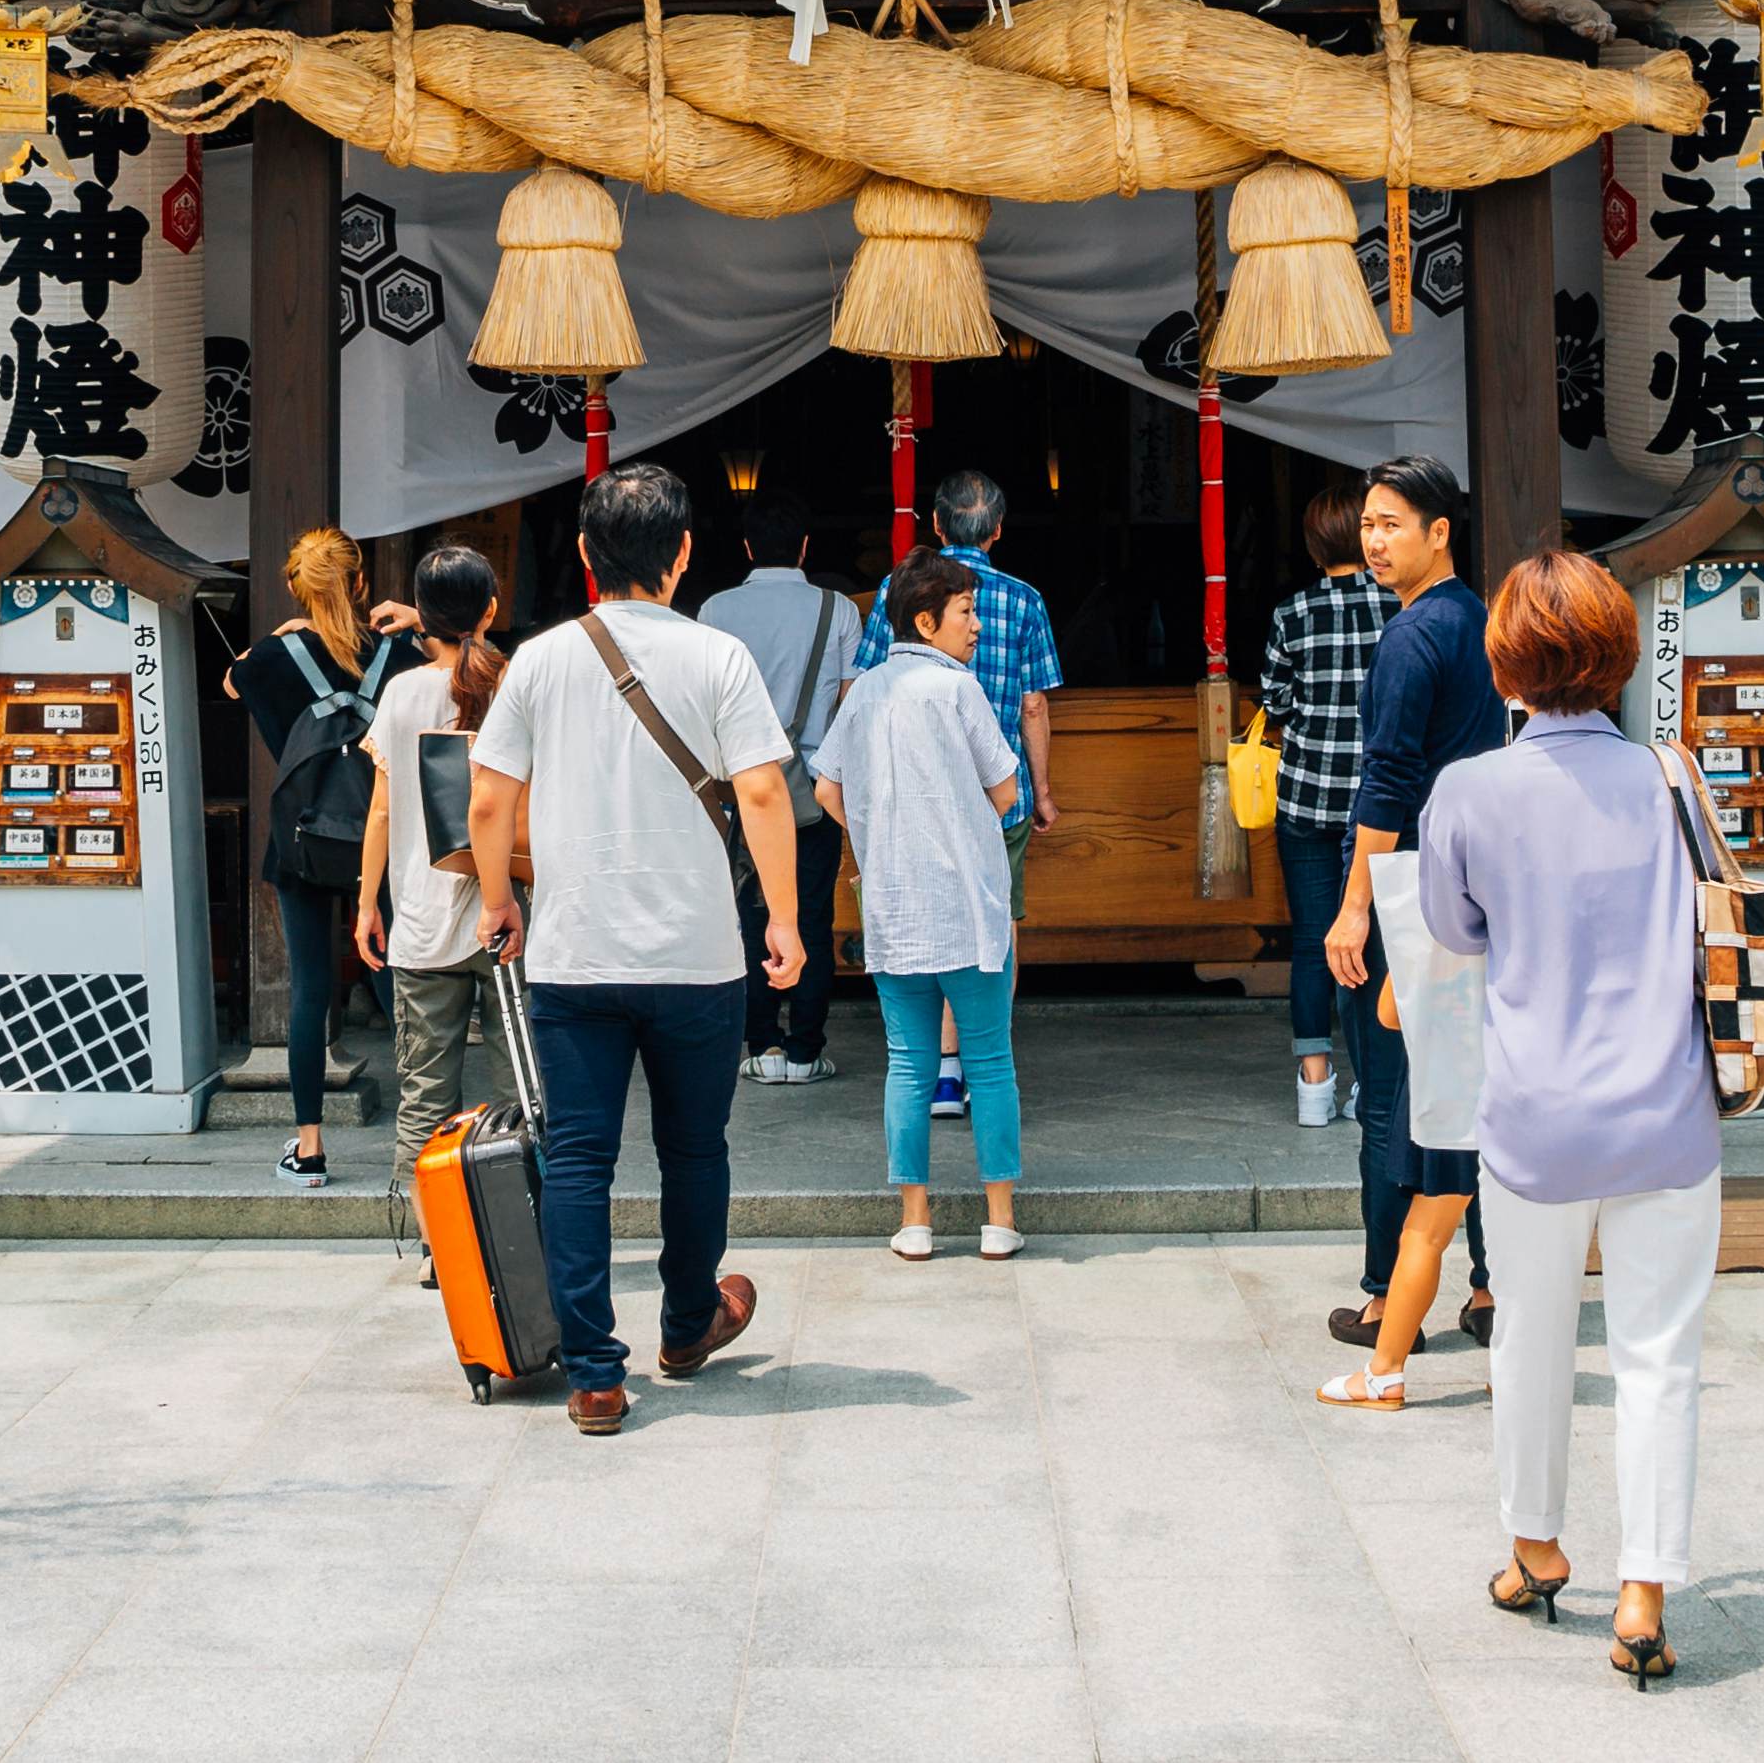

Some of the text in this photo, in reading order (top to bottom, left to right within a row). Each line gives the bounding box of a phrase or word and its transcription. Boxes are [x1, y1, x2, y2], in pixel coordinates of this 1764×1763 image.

[47, 708, 81, 719] 日本語
[1713, 751, 1734, 762] 英語
[19, 767, 41, 779] 英語
[77, 767, 112, 778] 韓国語
[8, 832, 42, 844] 中国語
[78, 833, 112, 845] 台湾語
